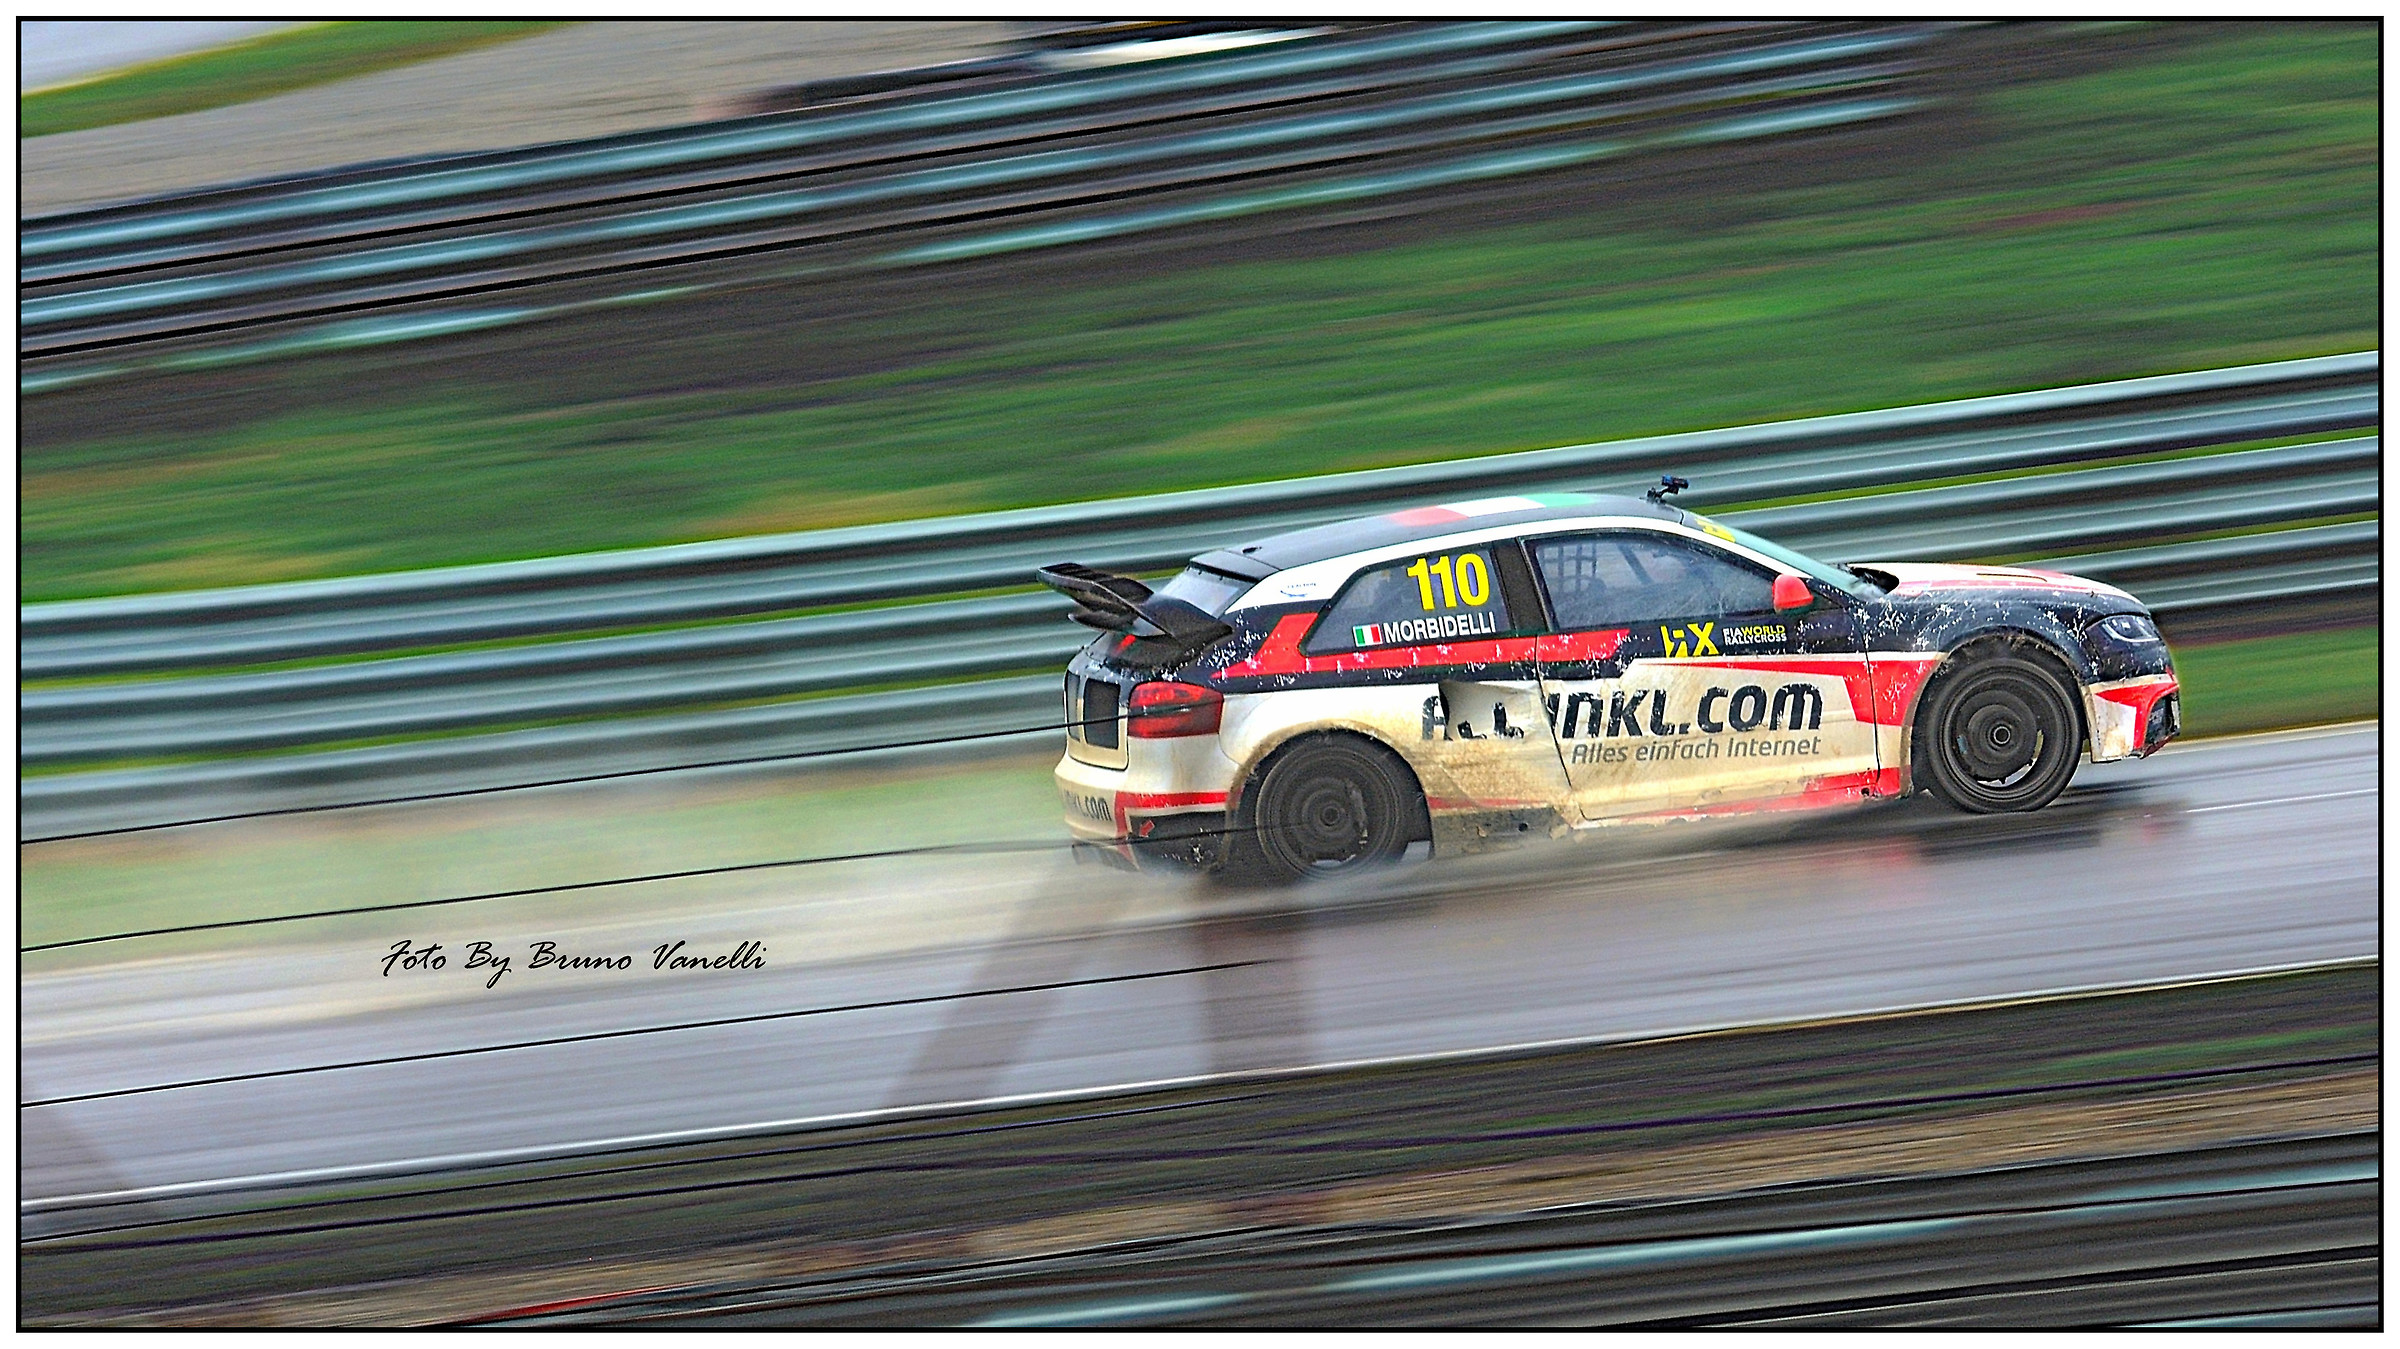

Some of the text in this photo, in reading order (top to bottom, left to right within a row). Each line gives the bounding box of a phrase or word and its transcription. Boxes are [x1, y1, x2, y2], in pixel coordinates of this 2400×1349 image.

[1407, 553, 1490, 610] 110
[1383, 611, 1496, 643] MORBIDELLI
[1724, 632, 1788, 646] RALLYCROSS
[1571, 736, 1822, 765] Alles einfach Internet
